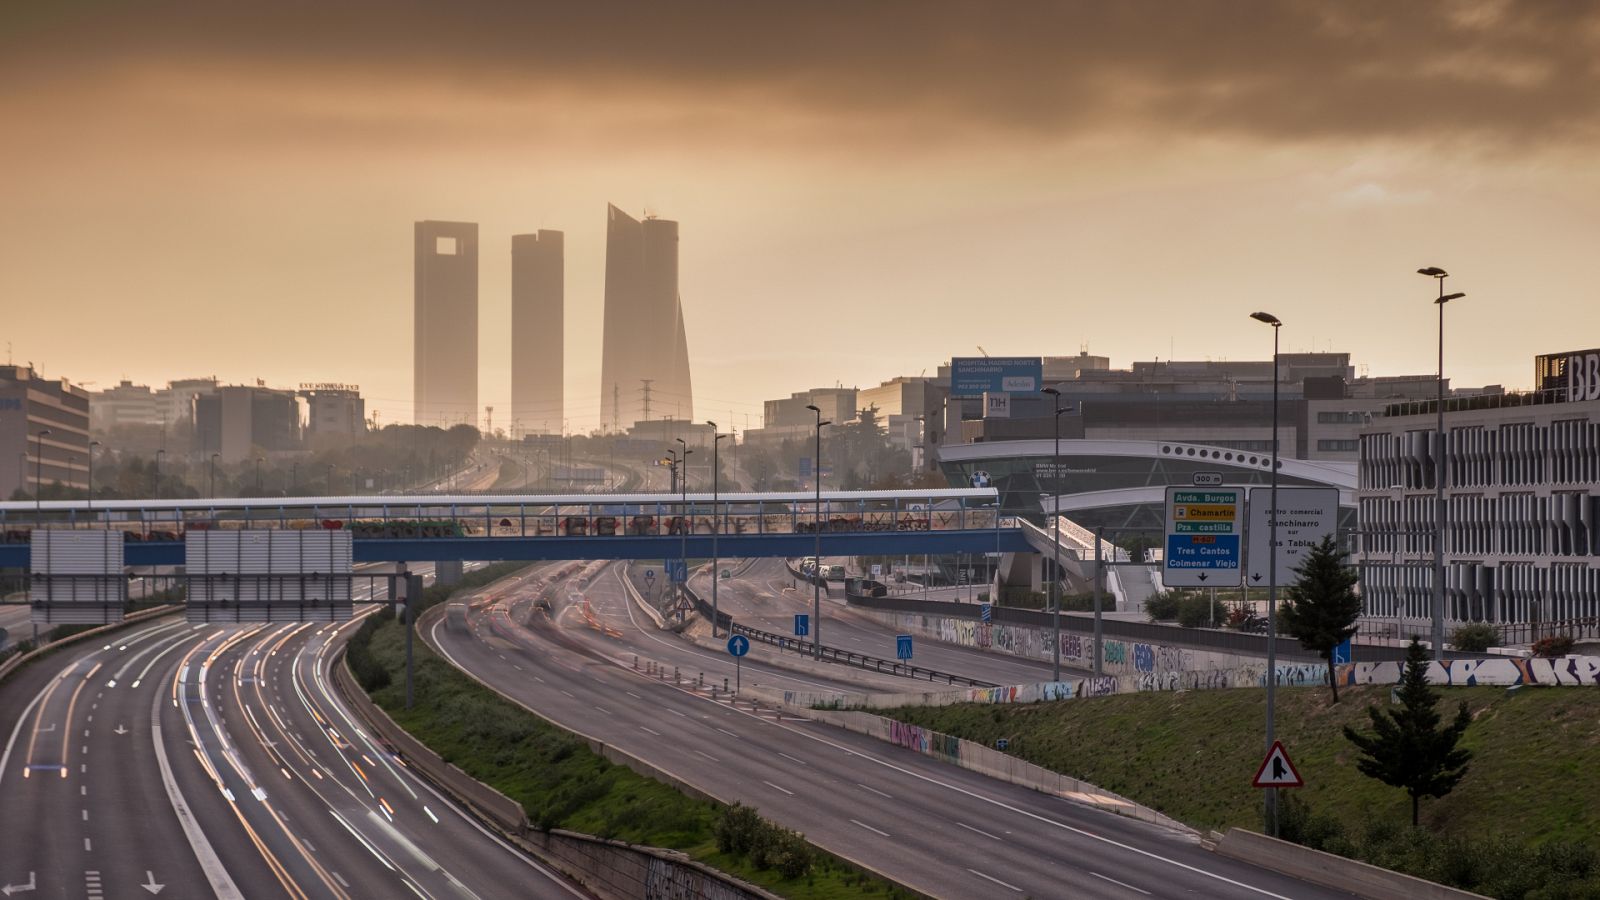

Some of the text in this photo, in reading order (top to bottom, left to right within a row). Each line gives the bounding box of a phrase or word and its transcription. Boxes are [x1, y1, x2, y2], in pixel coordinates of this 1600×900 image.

[1176, 494, 1234, 503] Avda. Burgos
[1177, 523, 1231, 531] Pza. castilla
[1287, 539, 1316, 547] Tablas
[1176, 547, 1230, 555] Tres Cantos
[1169, 559, 1236, 569] Colmenar Viejo
